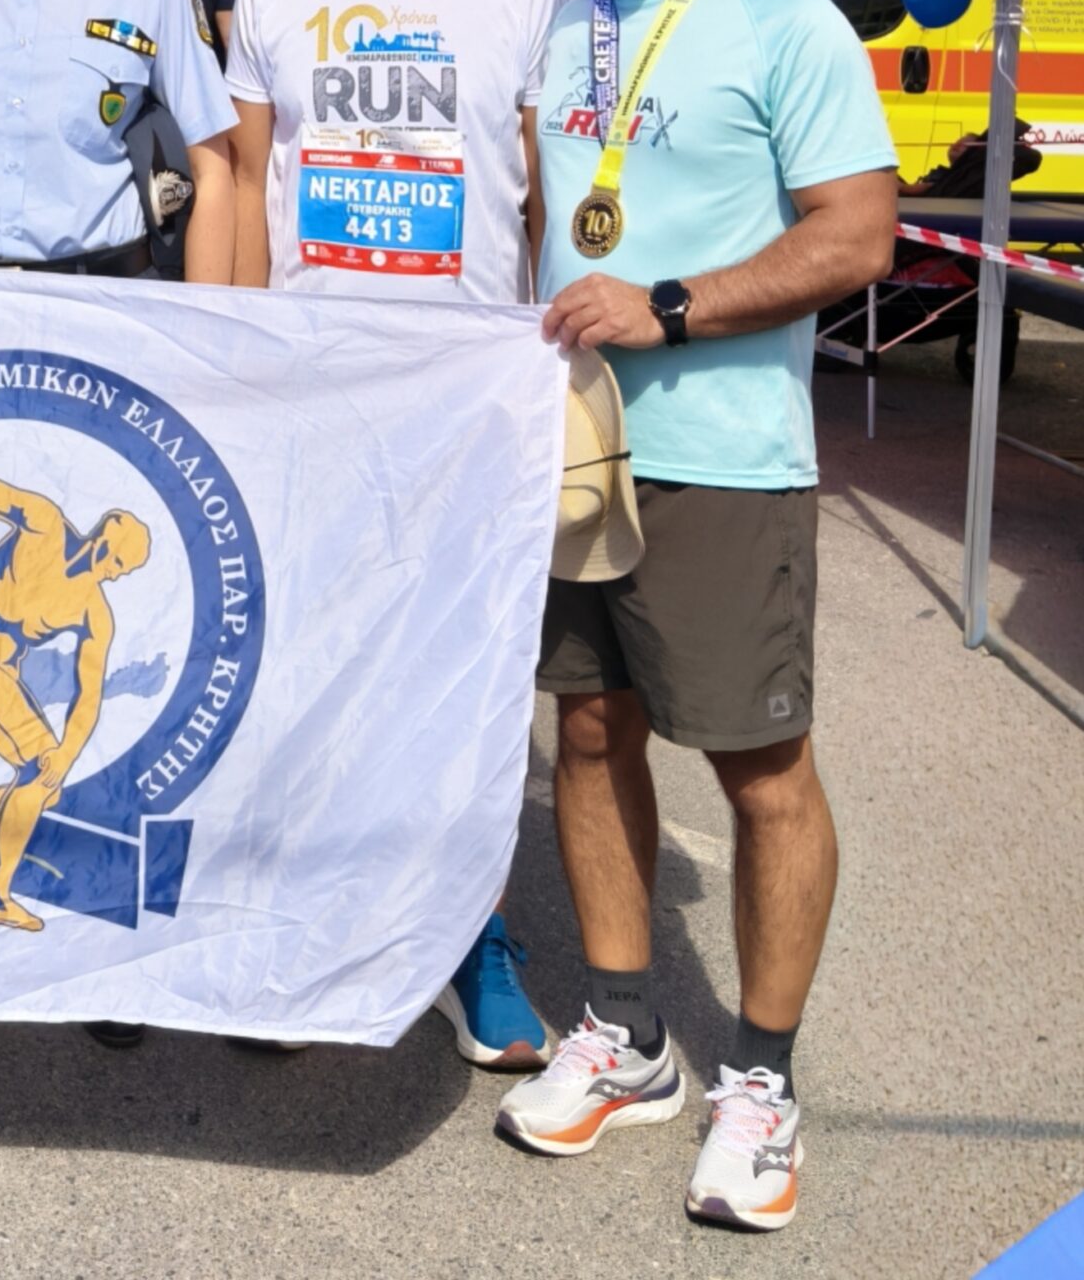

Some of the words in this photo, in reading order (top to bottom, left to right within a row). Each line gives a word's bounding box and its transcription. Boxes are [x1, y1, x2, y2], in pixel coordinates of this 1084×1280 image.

[304, 4, 388, 62] 10
[593, 21, 612, 82] CRETE
[312, 65, 457, 124] RUN
[310, 176, 454, 208] ΝΕΚΤΑΡΙΟΣ
[345, 215, 413, 243] 4413
[585, 210, 612, 235] 10
[118, 397, 239, 547] ΕΛΛΑΔΟΣ
[217, 552, 251, 646] ΠΑΡ.
[135, 656, 243, 802] ΚΡΗΤΗΣ
